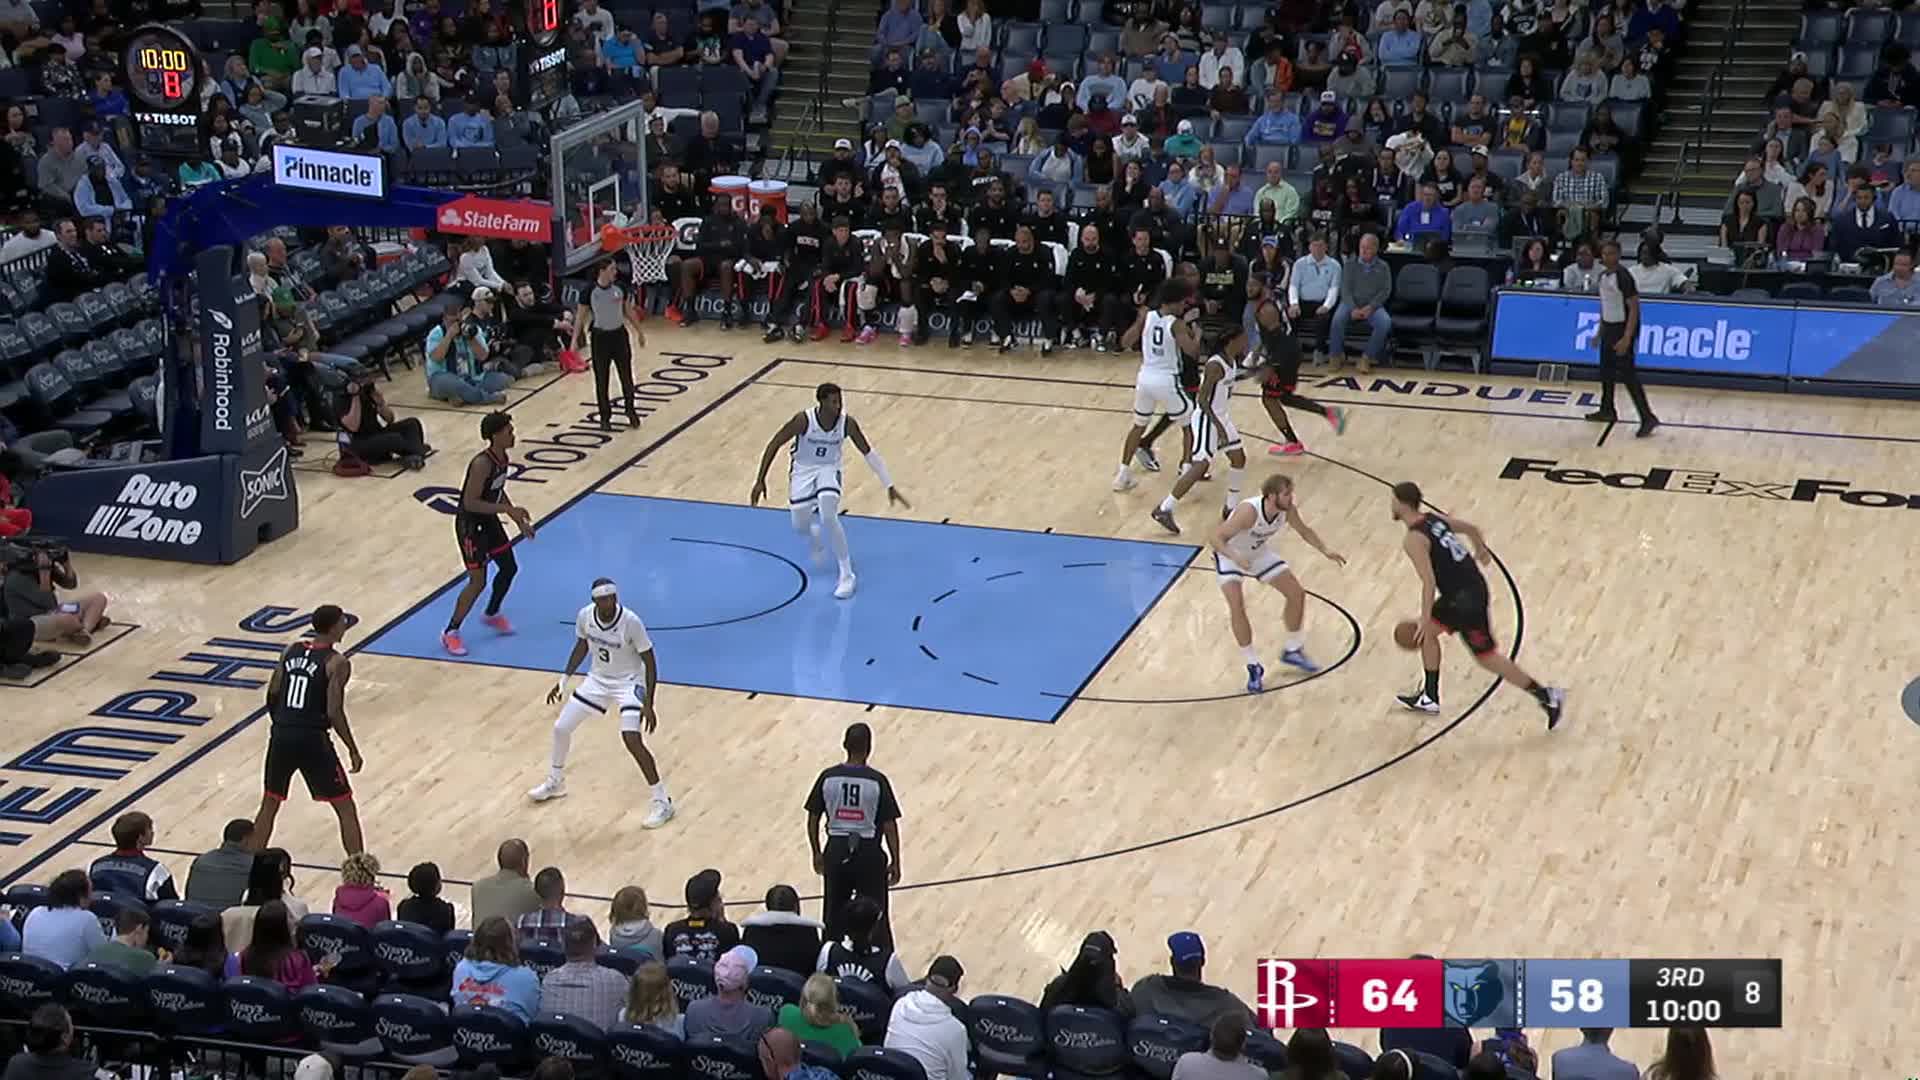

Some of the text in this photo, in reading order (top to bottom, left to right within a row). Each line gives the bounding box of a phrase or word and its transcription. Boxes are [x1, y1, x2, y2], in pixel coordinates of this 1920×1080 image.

[141, 48, 187, 71] 10:00
[164, 71, 181, 98] 8
[284, 155, 373, 188] Pinnacle
[1152, 325, 1165, 346] 0
[1575, 312, 1751, 361] Pnacle
[213, 333, 233, 431] Robinhood
[116, 473, 198, 511] Auto
[246, 467, 281, 500] SONIC
[117, 507, 203, 545] Zone
[598, 647, 611, 663] 3
[286, 673, 309, 709] 10
[841, 782, 861, 807] 19
